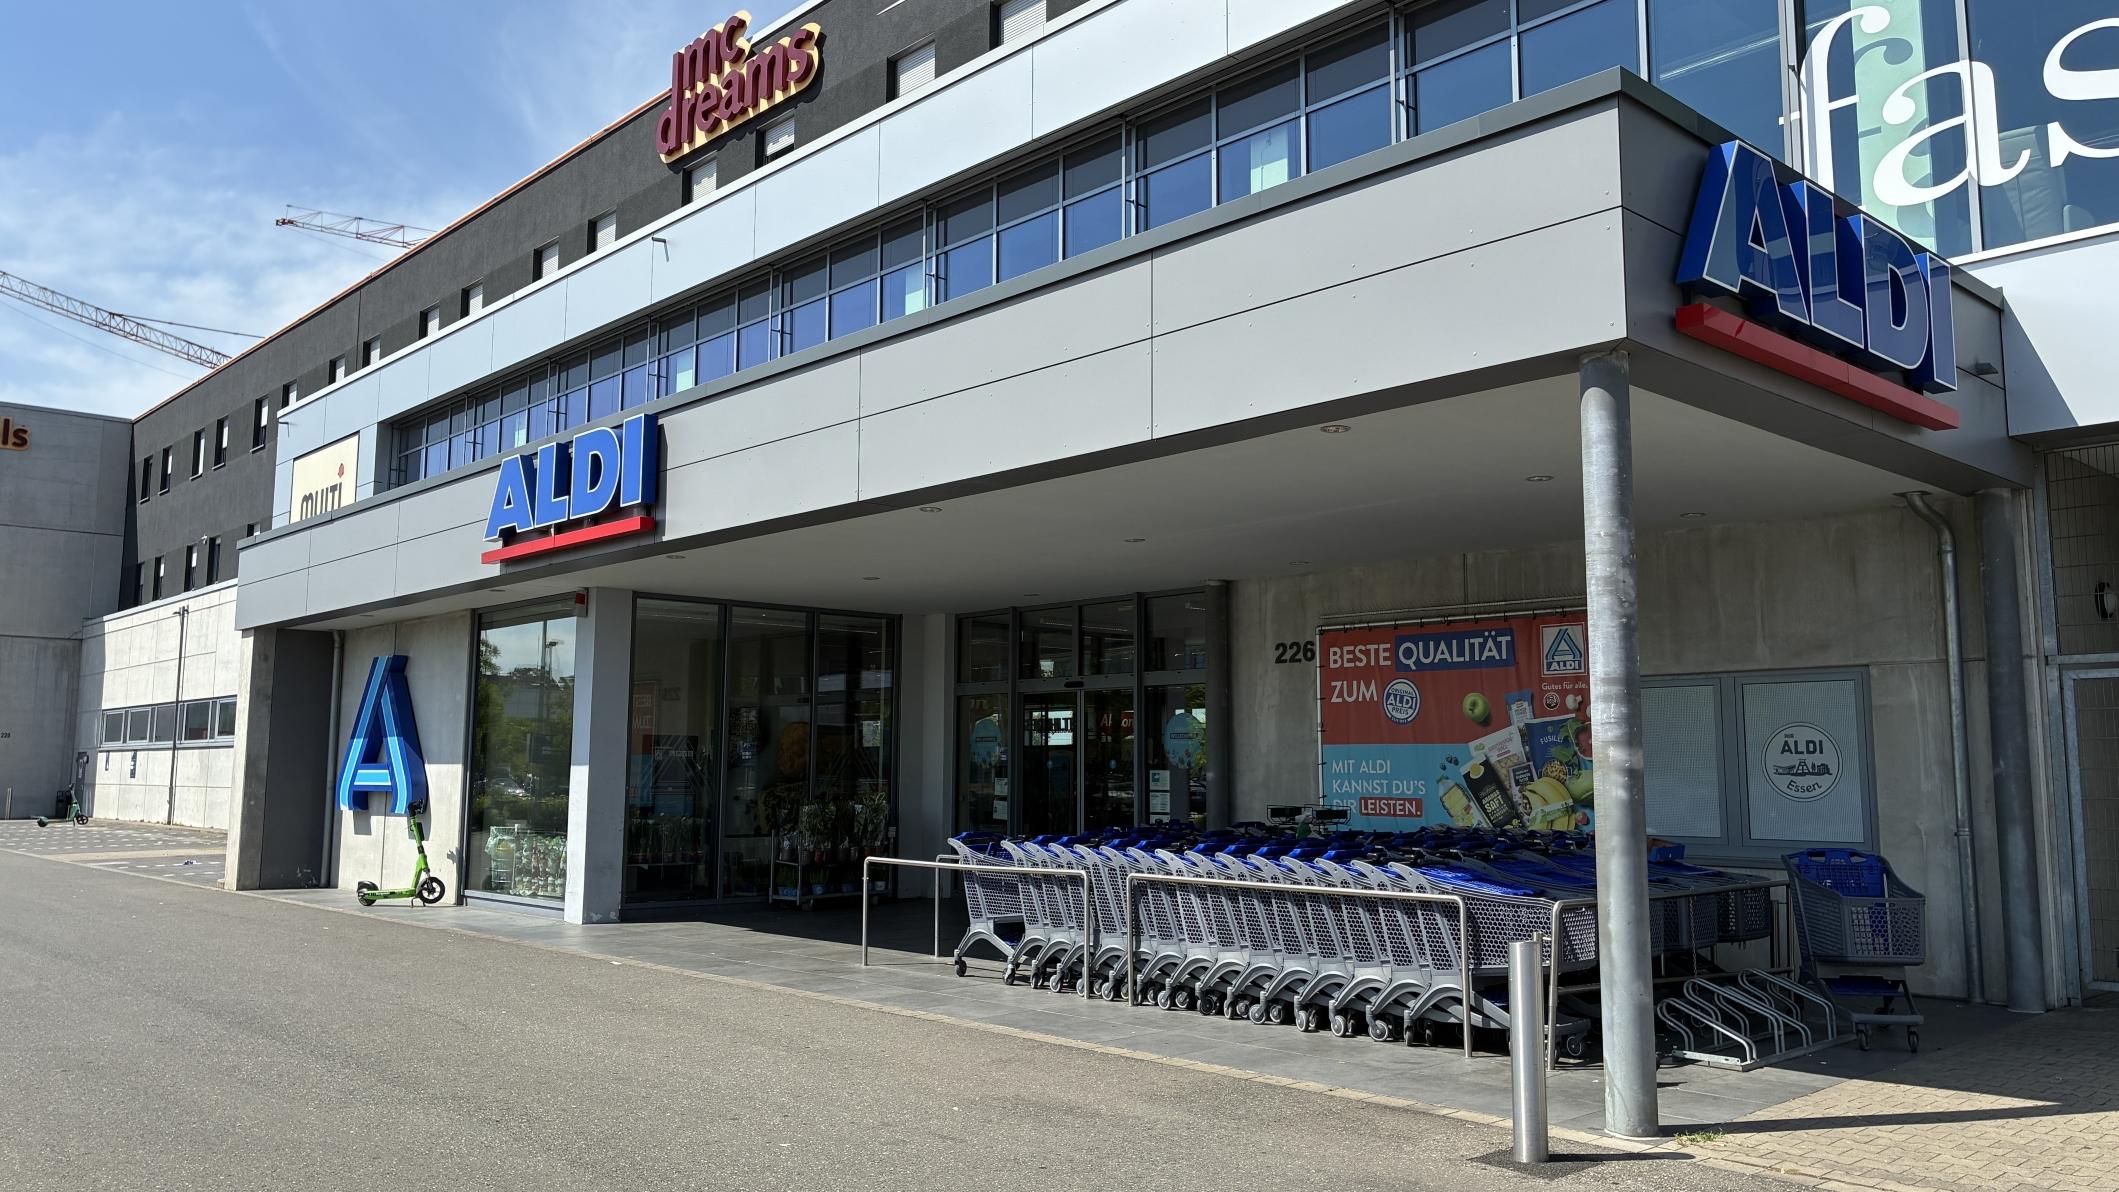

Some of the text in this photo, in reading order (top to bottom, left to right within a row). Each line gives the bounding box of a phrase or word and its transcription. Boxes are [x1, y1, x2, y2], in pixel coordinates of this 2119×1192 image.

[683, 13, 748, 91] mc
[656, 28, 819, 155] dreams
[1677, 140, 1958, 393] ALDI
[483, 413, 658, 542] ALDI
[1275, 641, 1315, 664] 226
[1329, 631, 1512, 670] BESTE QUALITÄT
[1549, 660, 1579, 671] ALDI
[1330, 679, 1378, 703] ZUM
[1541, 682, 1562, 691] Gutes
[1563, 681, 1573, 690] für
[1387, 694, 1416, 709] ALDI
[1780, 739, 1824, 755] ALDI
[1332, 759, 1391, 774] MIT ALDI
[1333, 779, 1389, 794] KANNST
[1786, 779, 1823, 793] Essen
[1332, 799, 1422, 815] DIR LEISTEN.
[1484, 794, 1504, 813] SAFT
